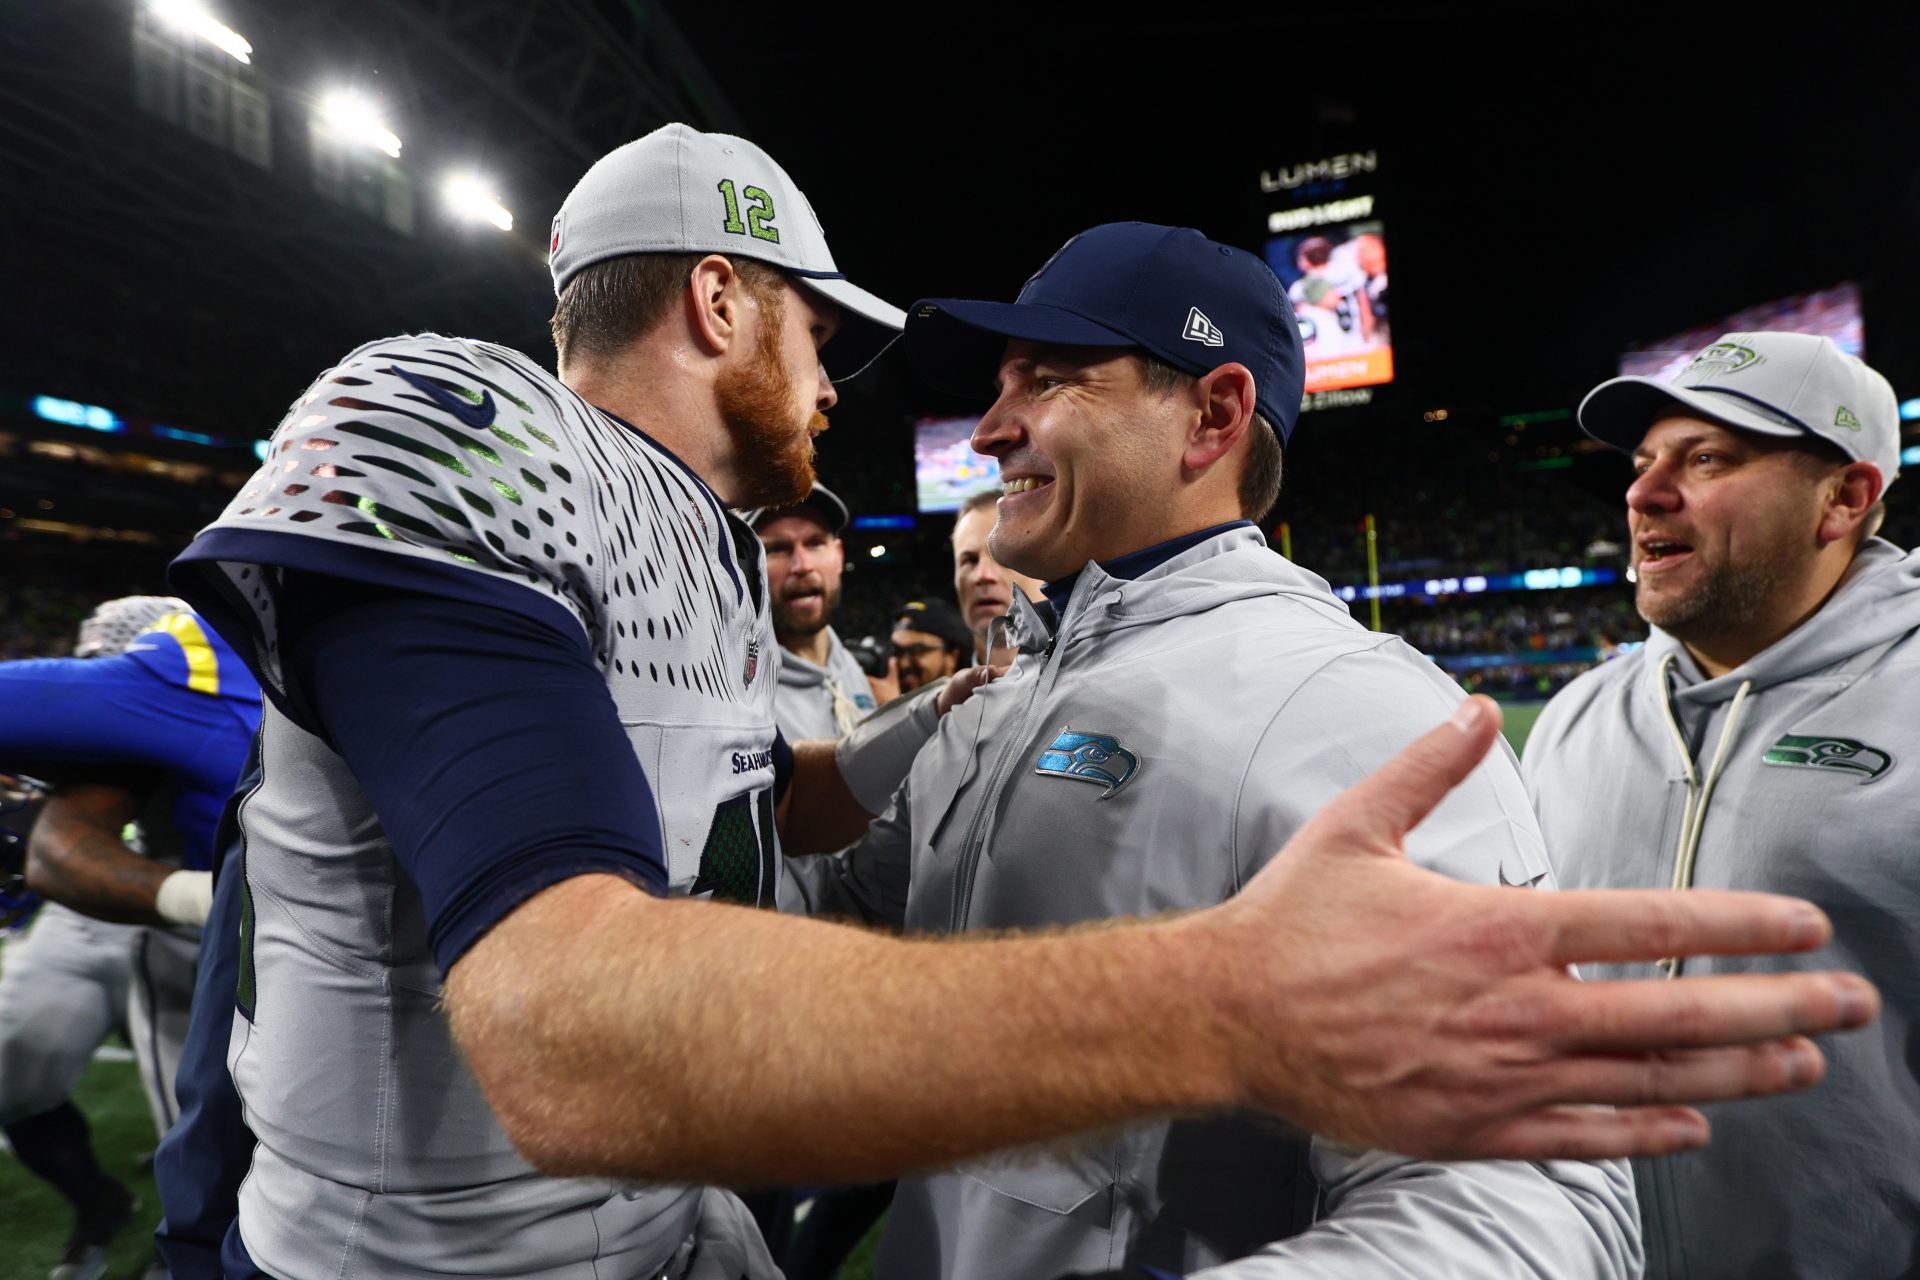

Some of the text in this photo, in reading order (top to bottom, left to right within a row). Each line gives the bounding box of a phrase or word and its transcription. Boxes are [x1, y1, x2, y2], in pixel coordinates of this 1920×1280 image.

[1261, 150, 1377, 193] LUMEN
[717, 178, 781, 245] 12
[731, 750, 773, 775] SEAHAW
